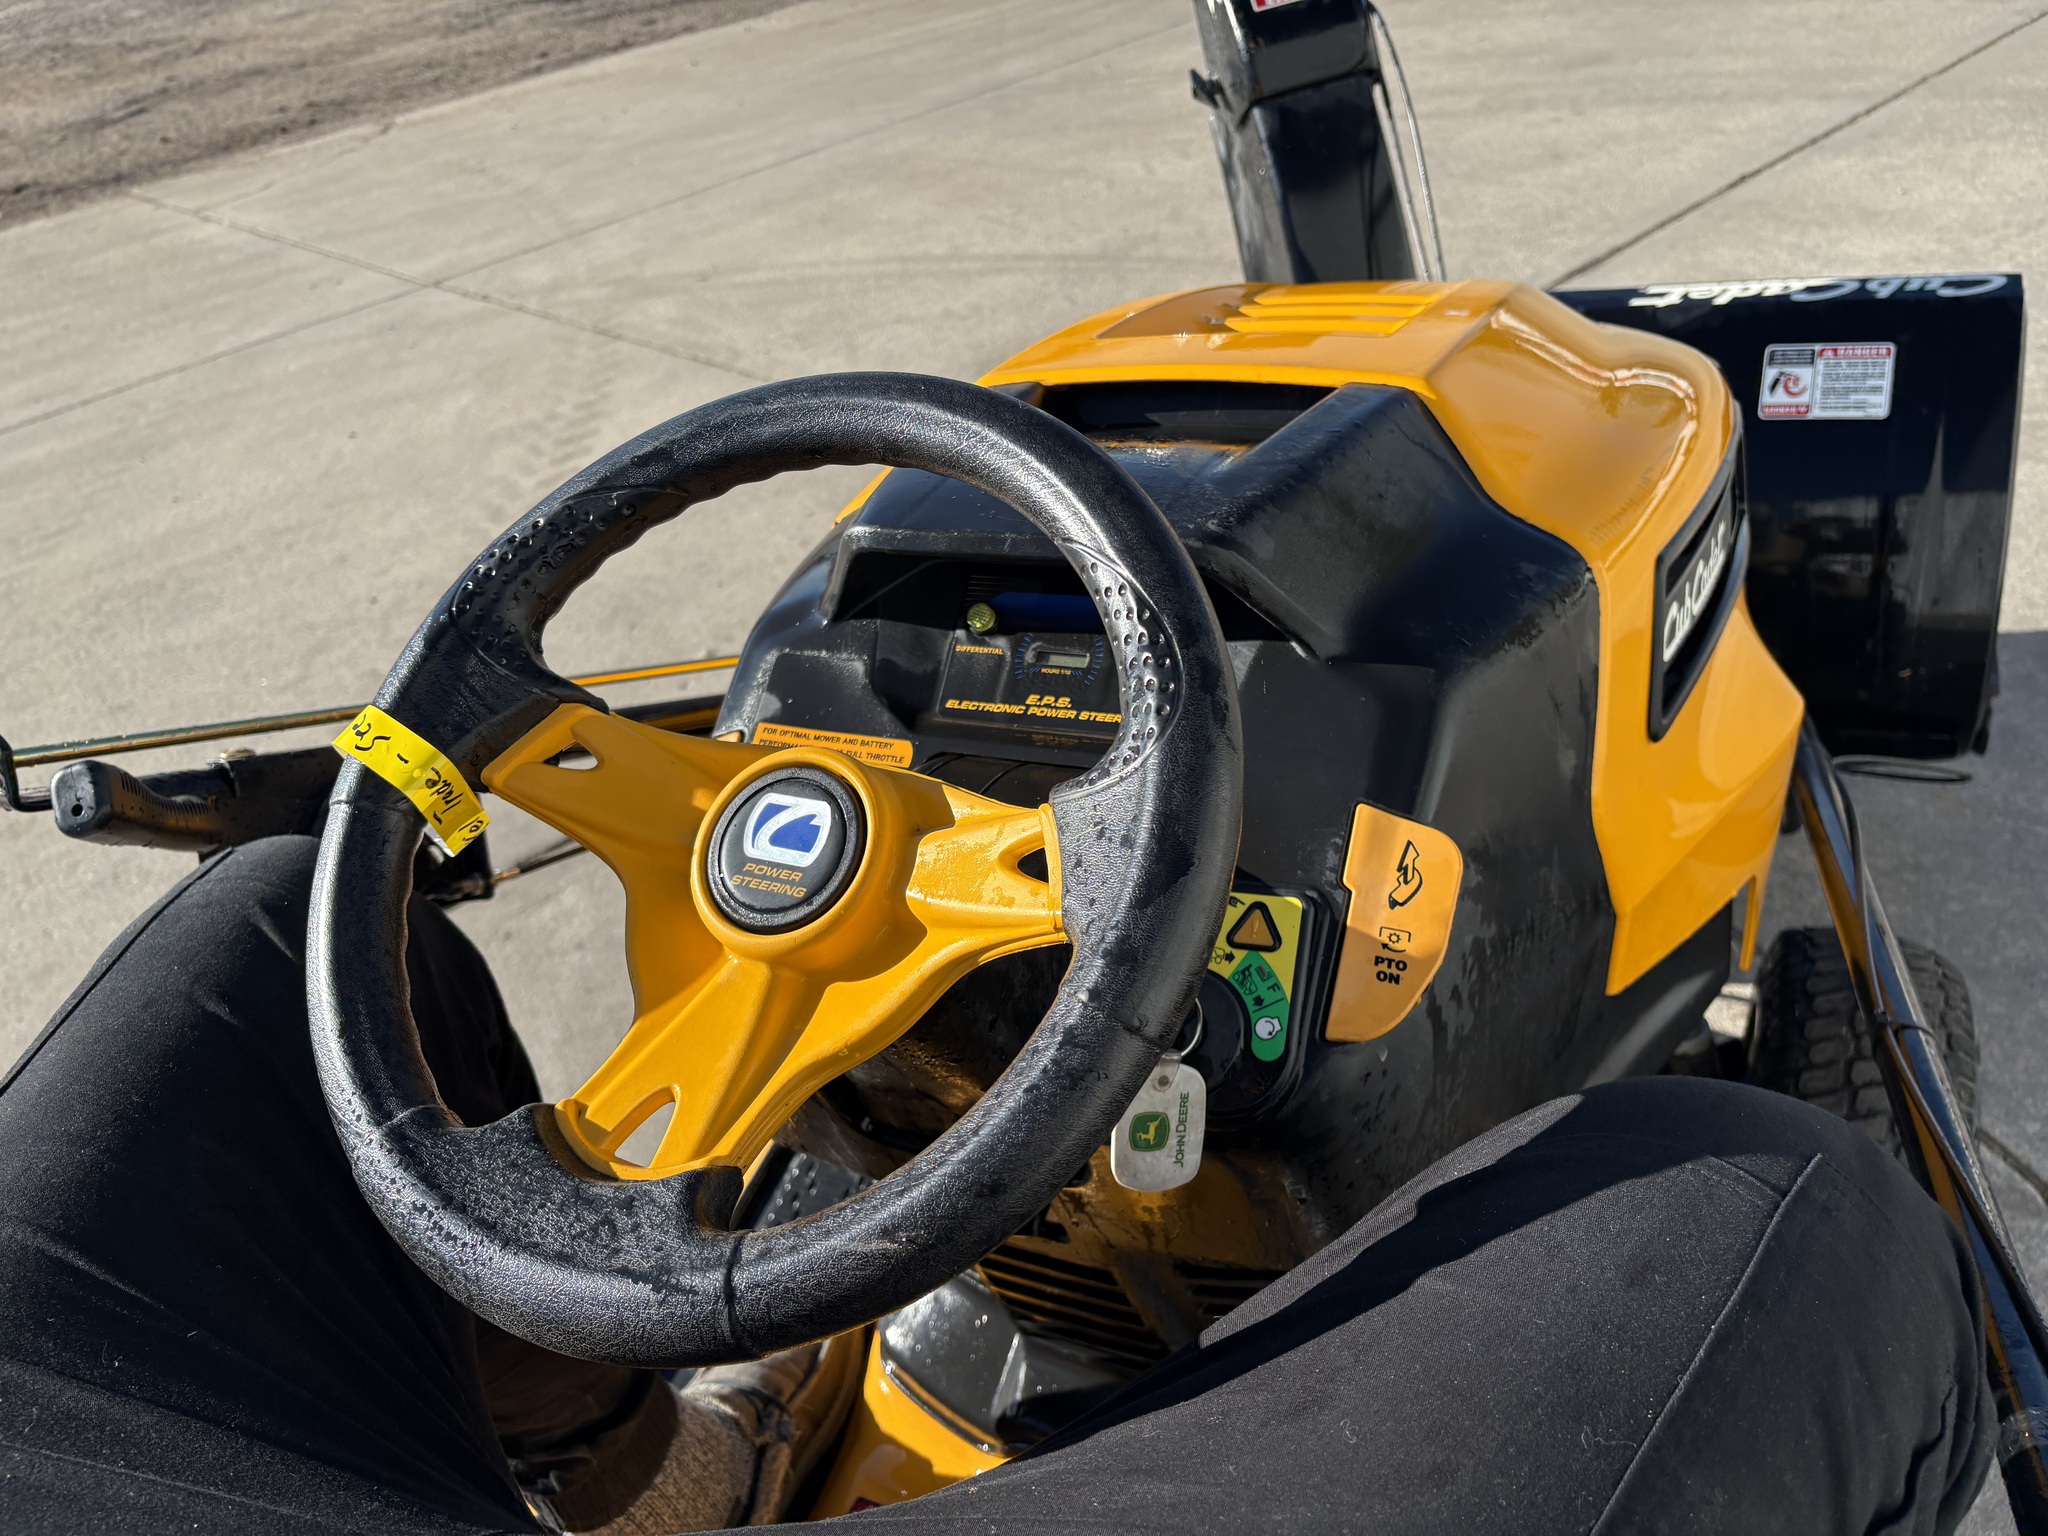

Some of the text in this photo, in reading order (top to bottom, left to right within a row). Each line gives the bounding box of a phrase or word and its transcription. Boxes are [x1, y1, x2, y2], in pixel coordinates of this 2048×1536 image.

[1628, 275, 2008, 307] Cub Cadet
[1663, 520, 1727, 662] Cub Cadet
[955, 645, 1004, 655] DIFFERENTIAL
[1041, 667, 1061, 675] HOURS
[945, 699, 1026, 715] ELECTRONIC
[1027, 707, 1077, 720] POWER
[1025, 693, 1073, 709] E.P.S.
[762, 727, 895, 750] FOR OPTIMAL MOWER AND BATTERY
[866, 752, 905, 764] THROTTLE
[743, 863, 803, 882] POWER
[731, 874, 807, 898] STEERING
[1374, 955, 1408, 973] PTO
[1376, 969, 1401, 986] ON
[1267, 983, 1281, 997] F
[1173, 1092, 1190, 1168] JOHN DEERE
